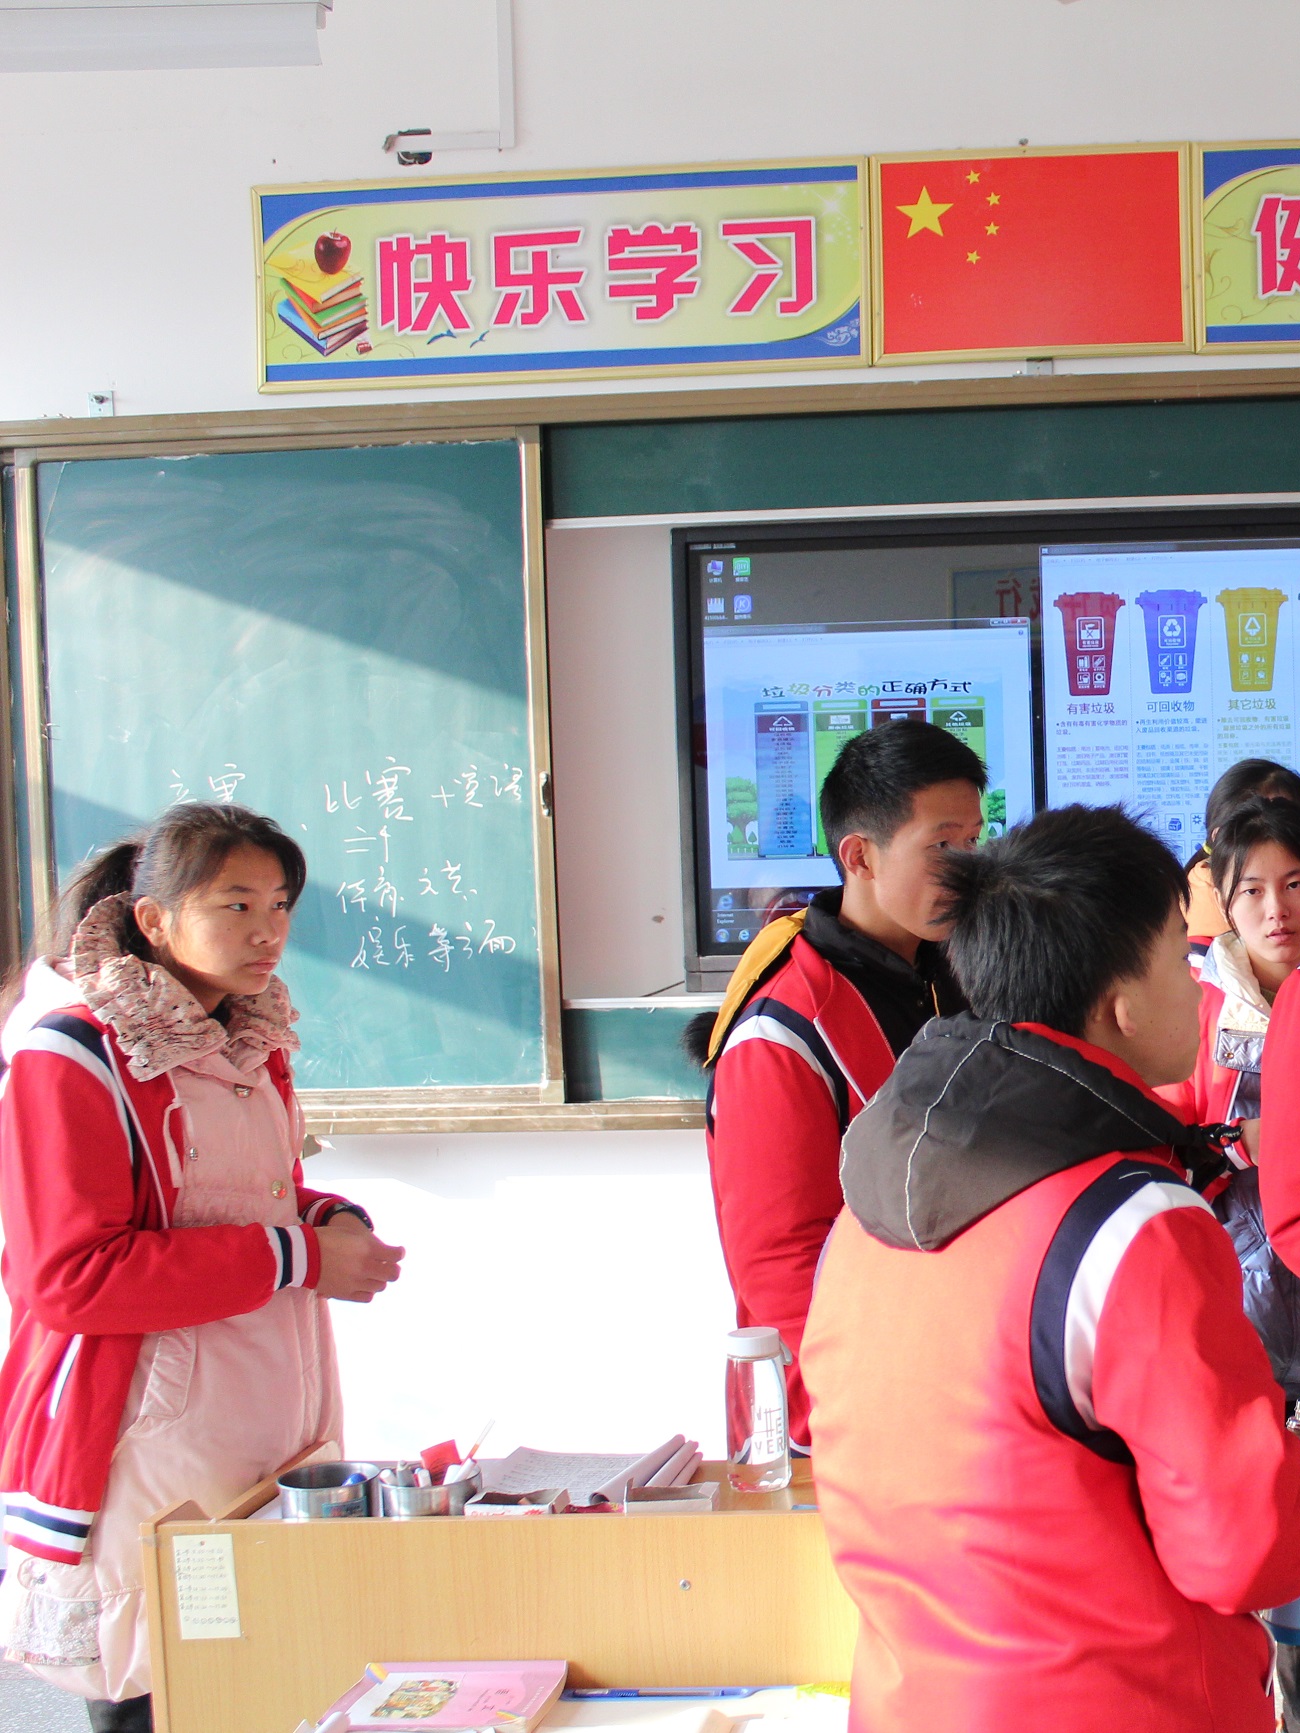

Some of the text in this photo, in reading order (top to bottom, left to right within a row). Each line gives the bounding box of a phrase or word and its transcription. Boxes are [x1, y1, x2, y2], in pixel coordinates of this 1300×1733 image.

[377, 217, 818, 335] 快乐学习
[762, 678, 972, 698] 垃圾分类的正确方式
[1067, 703, 1115, 715] 有害垃圾
[1147, 701, 1195, 712] 可回收物
[1228, 699, 1276, 710] 其它垃圾
[324, 756, 414, 822] 比赛
